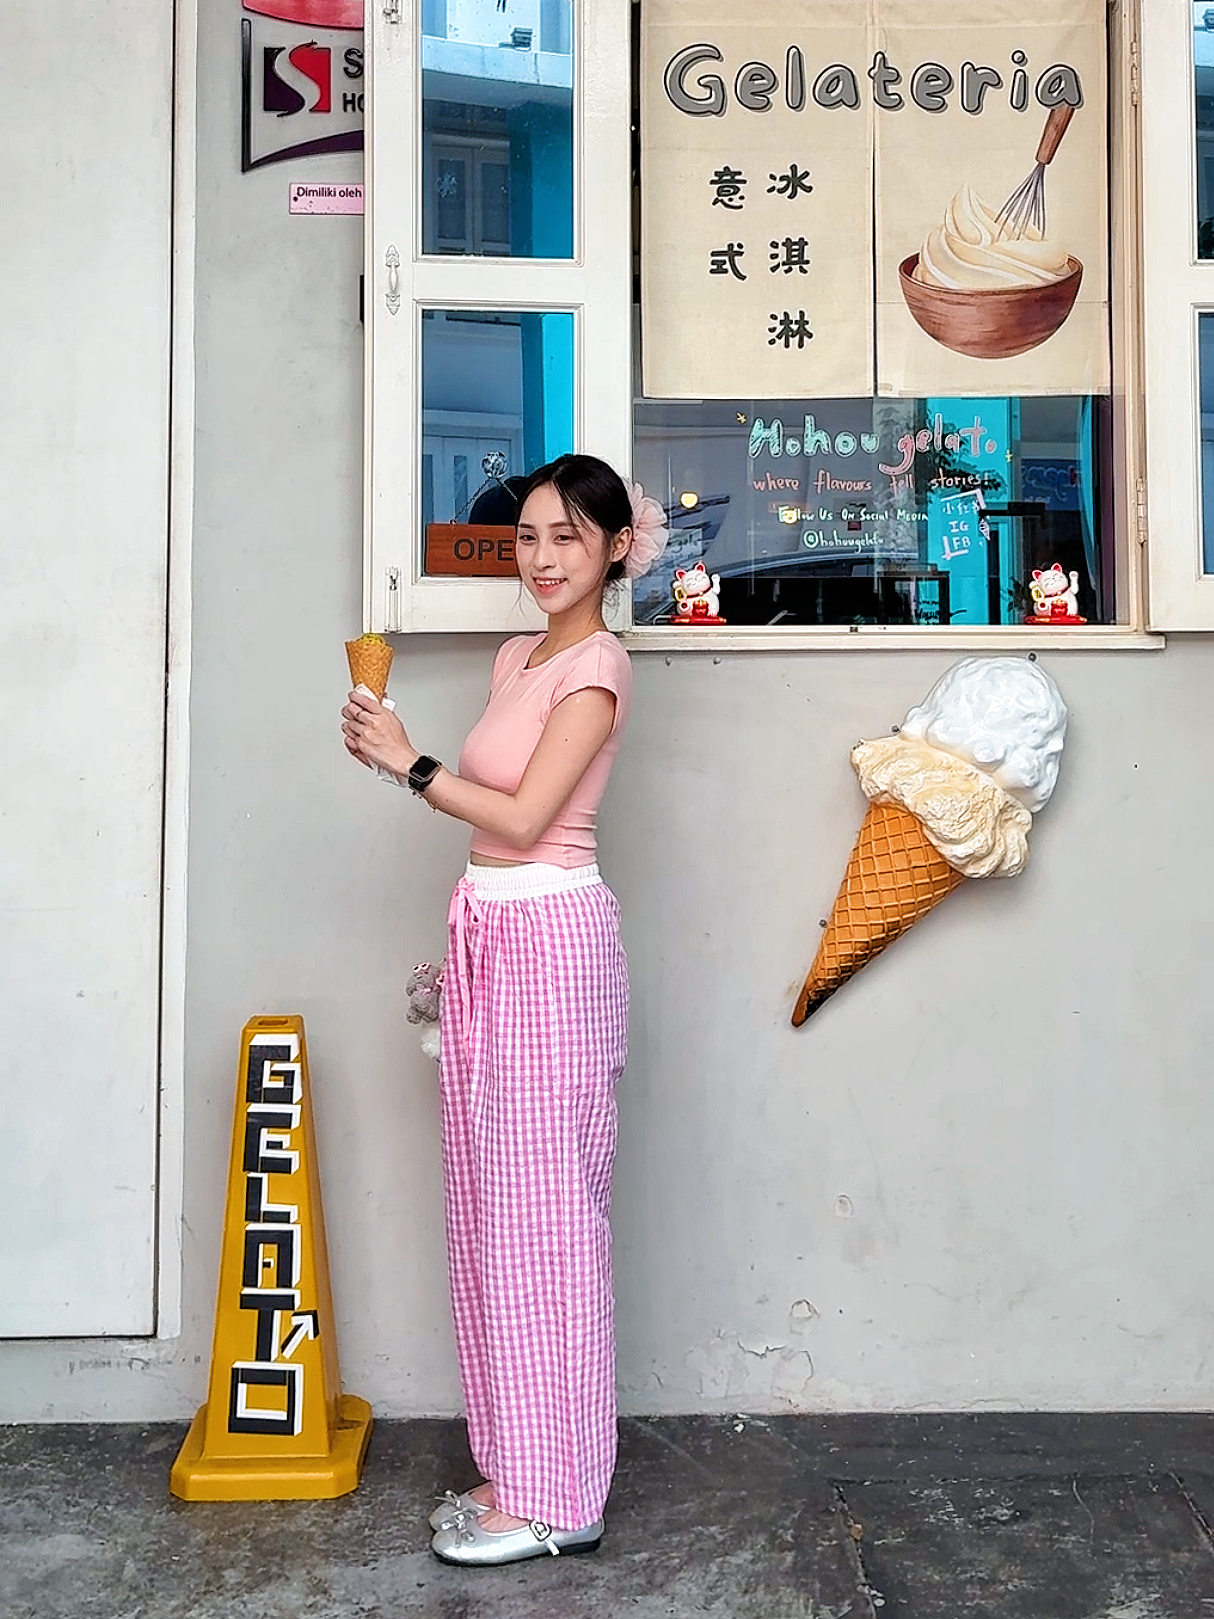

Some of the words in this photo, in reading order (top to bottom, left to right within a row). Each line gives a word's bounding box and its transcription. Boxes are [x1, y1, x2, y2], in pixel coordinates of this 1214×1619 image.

[664, 43, 1084, 116] Gelateria
[297, 186, 336, 198] Dimiliki
[338, 186, 362, 198] oleh
[709, 166, 748, 282] 意式
[767, 164, 814, 349] 冰淇淋
[878, 412, 997, 476] gelato
[753, 472, 799, 491] where
[813, 469, 872, 494] flavours
[890, 474, 914, 498] tell
[928, 467, 989, 489] stories!
[819, 507, 834, 521] Us
[949, 521, 969, 533] IG
[952, 535, 971, 550] FB
[228, 1033, 304, 1437] GELATO
